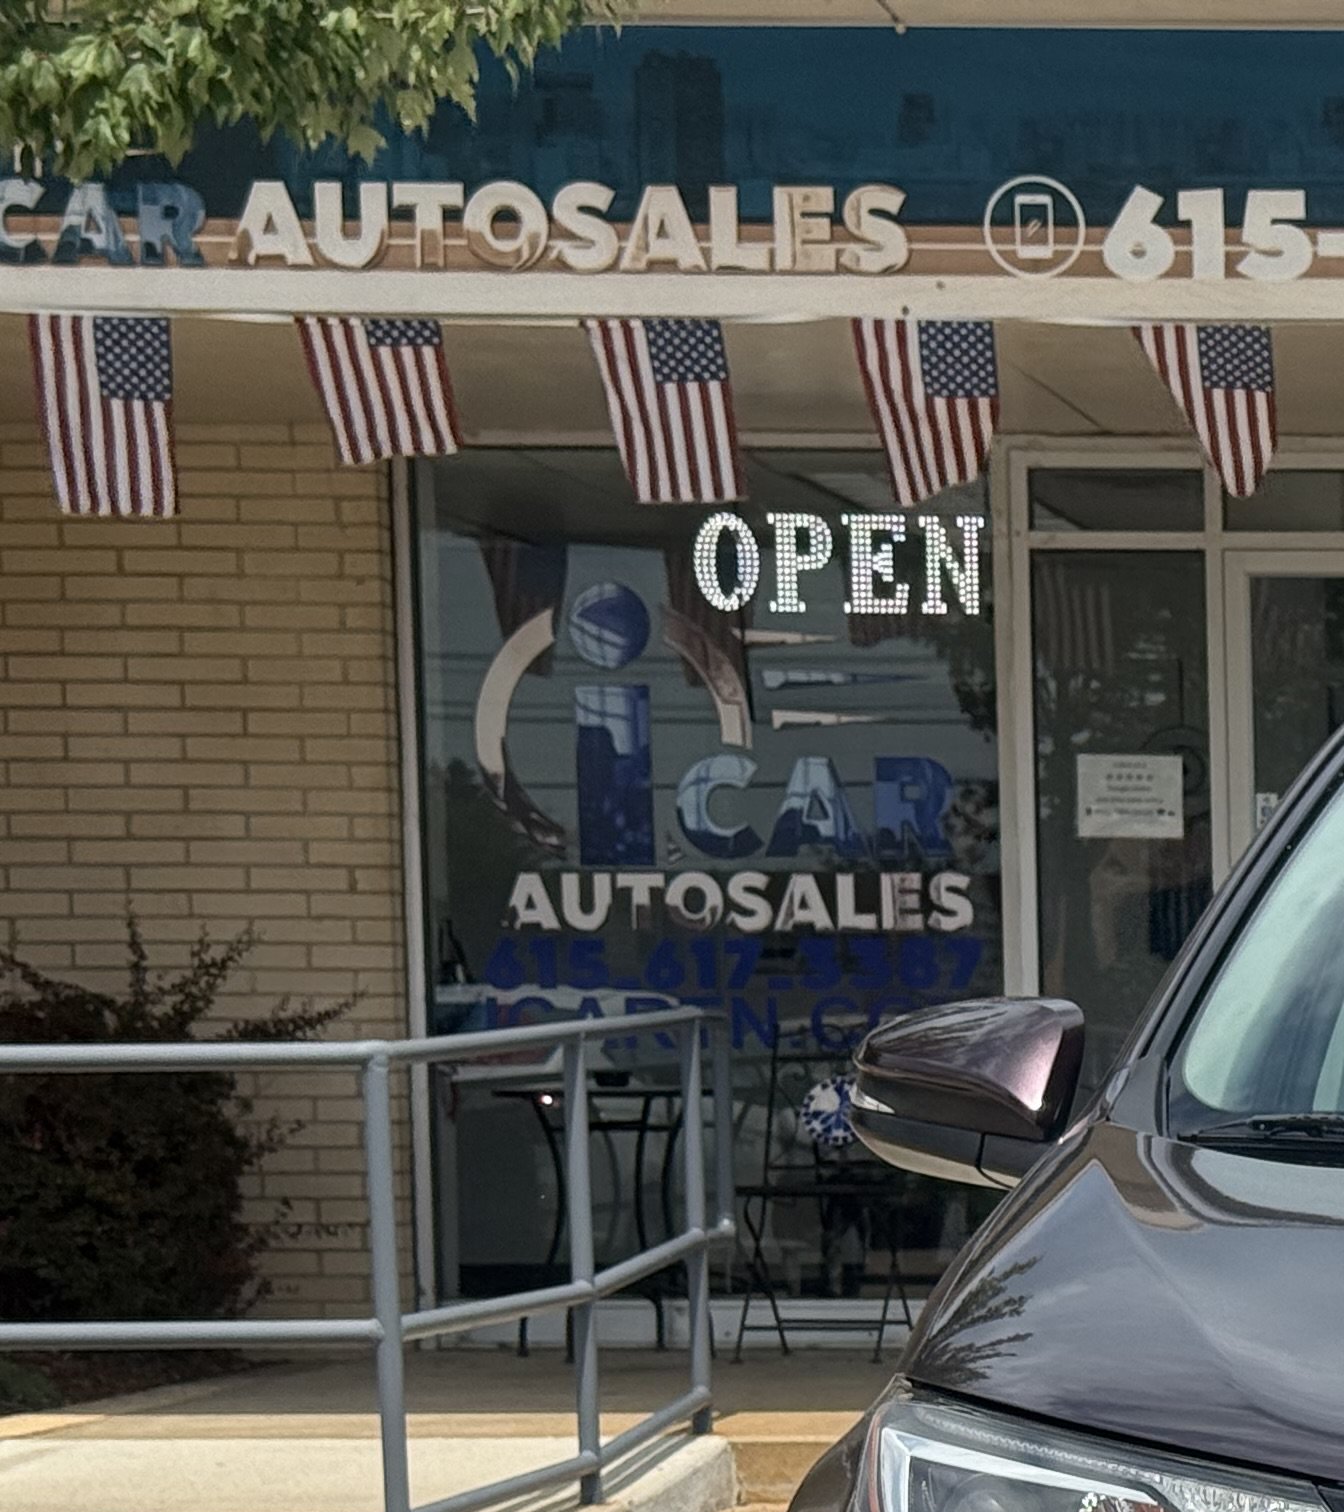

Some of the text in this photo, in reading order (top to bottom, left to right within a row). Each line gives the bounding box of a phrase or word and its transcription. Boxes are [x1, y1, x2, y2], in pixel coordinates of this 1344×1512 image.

[228, 179, 908, 273] AUTOSALES
[693, 511, 986, 615] OPEN
[503, 871, 977, 932] AUTOSALES
